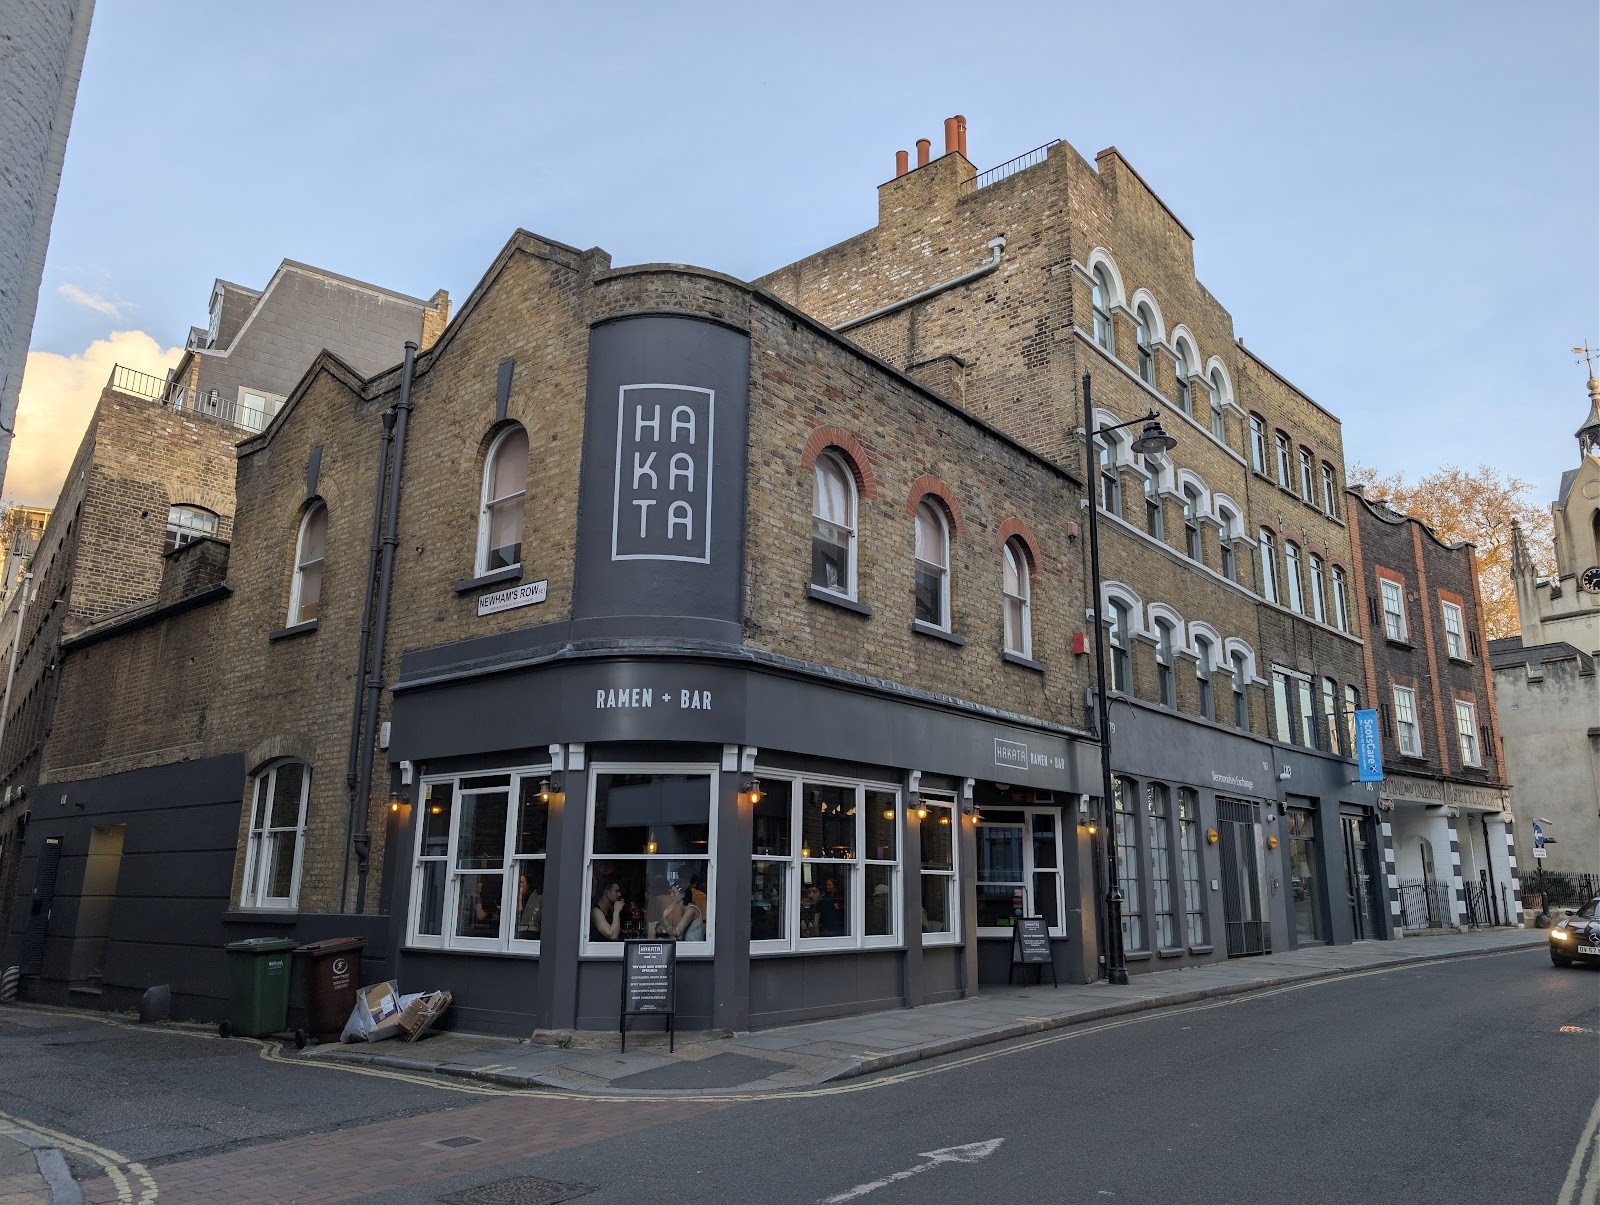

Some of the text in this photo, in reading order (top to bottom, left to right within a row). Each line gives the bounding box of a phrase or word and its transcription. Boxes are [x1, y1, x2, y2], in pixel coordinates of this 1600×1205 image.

[479, 589, 519, 608] NEWHAM'S
[519, 584, 540, 599] ROW
[596, 688, 712, 710] RAMEN + BAR
[1363, 718, 1376, 765] ScotsCare
[996, 746, 1026, 763] HAKATA
[1030, 752, 1048, 767] RAMEN
[1054, 757, 1065, 770] BAR
[1211, 770, 1254, 791] Bermondsey Exchange
